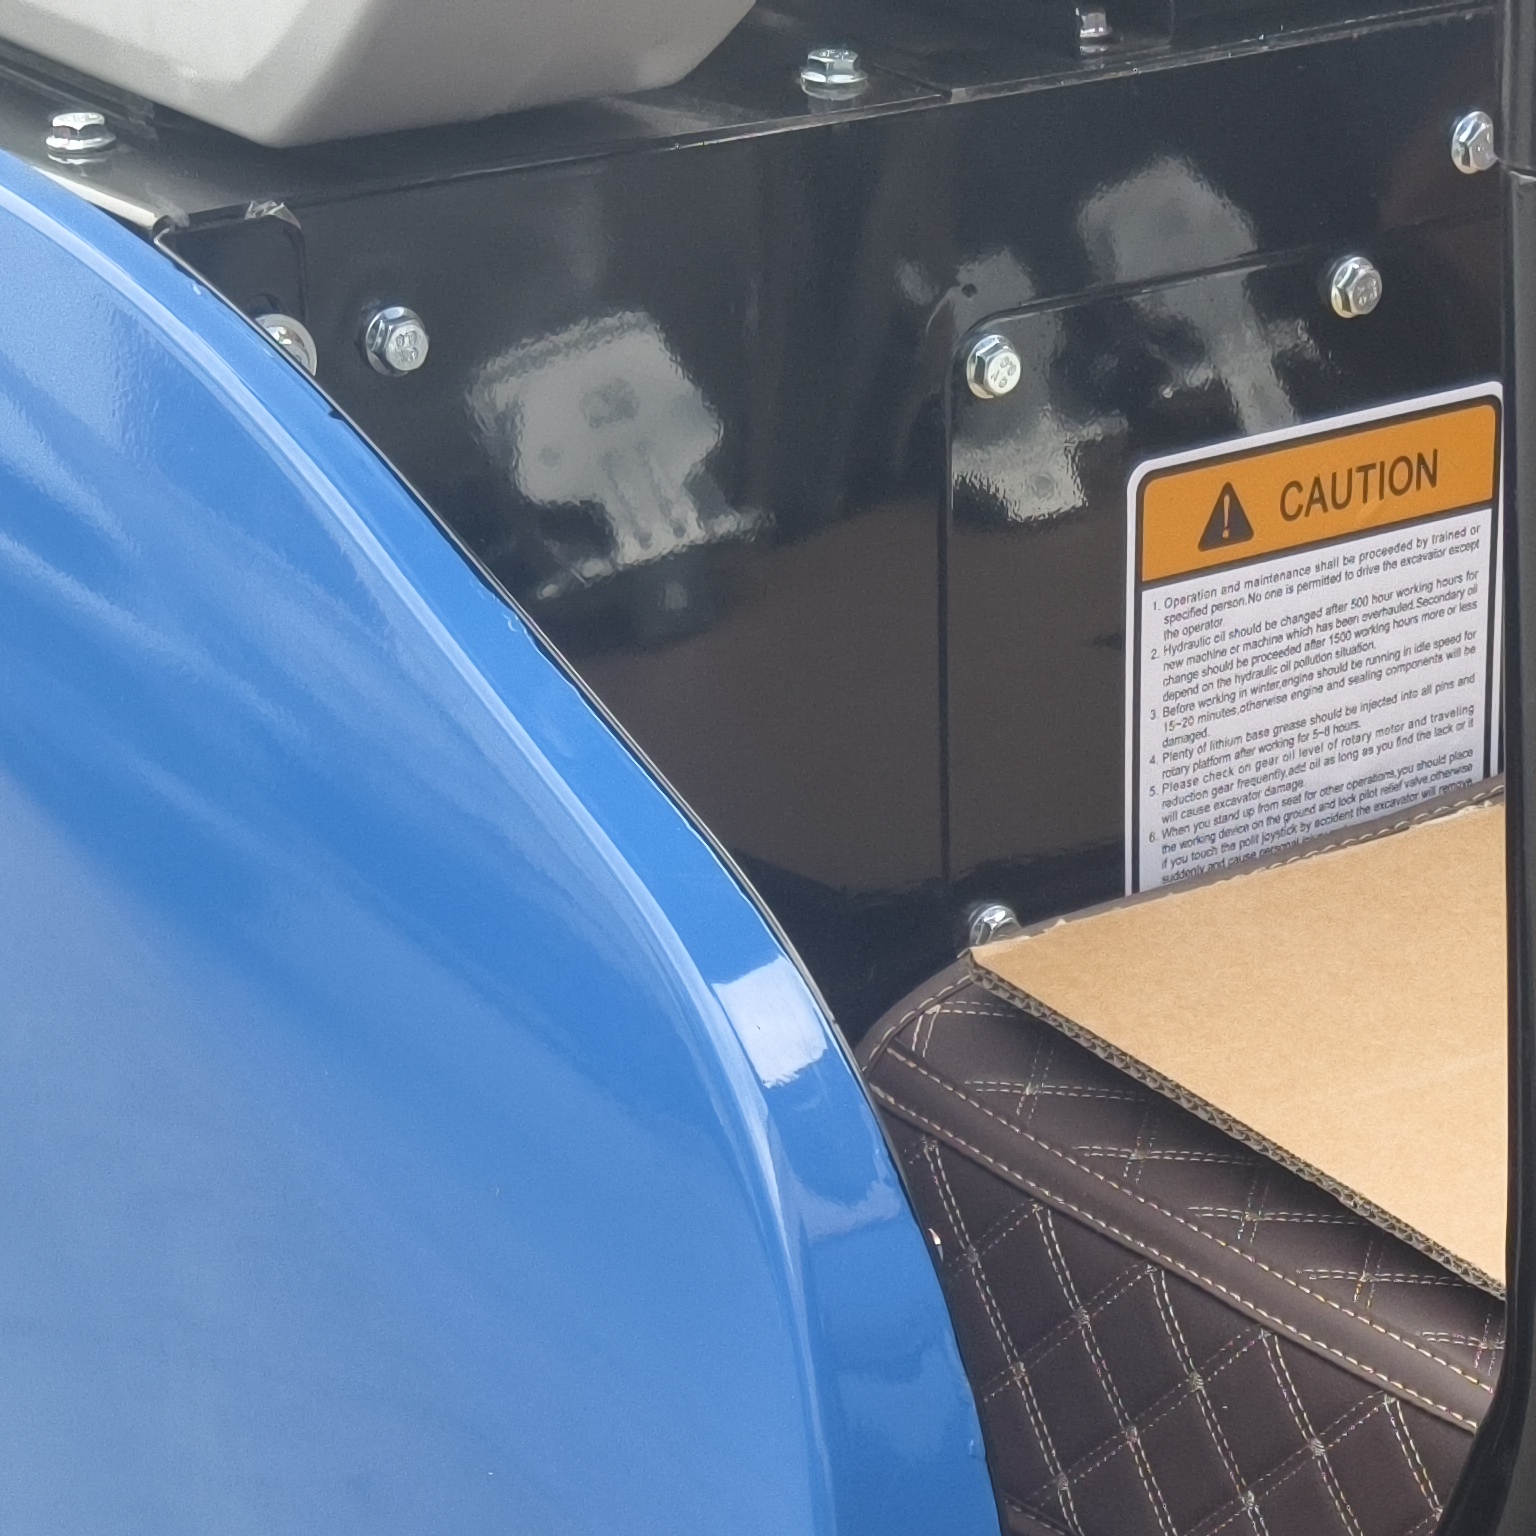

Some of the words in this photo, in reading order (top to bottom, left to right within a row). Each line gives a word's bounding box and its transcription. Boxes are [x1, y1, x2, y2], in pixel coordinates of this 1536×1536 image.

[1280, 449, 1439, 521] CAUTION
[1221, 580, 1240, 595] and
[1416, 537, 1428, 549] by
[1469, 525, 1480, 535] or
[1228, 622, 1261, 640] should
[1264, 619, 1277, 631] be
[1396, 582, 1433, 598] working
